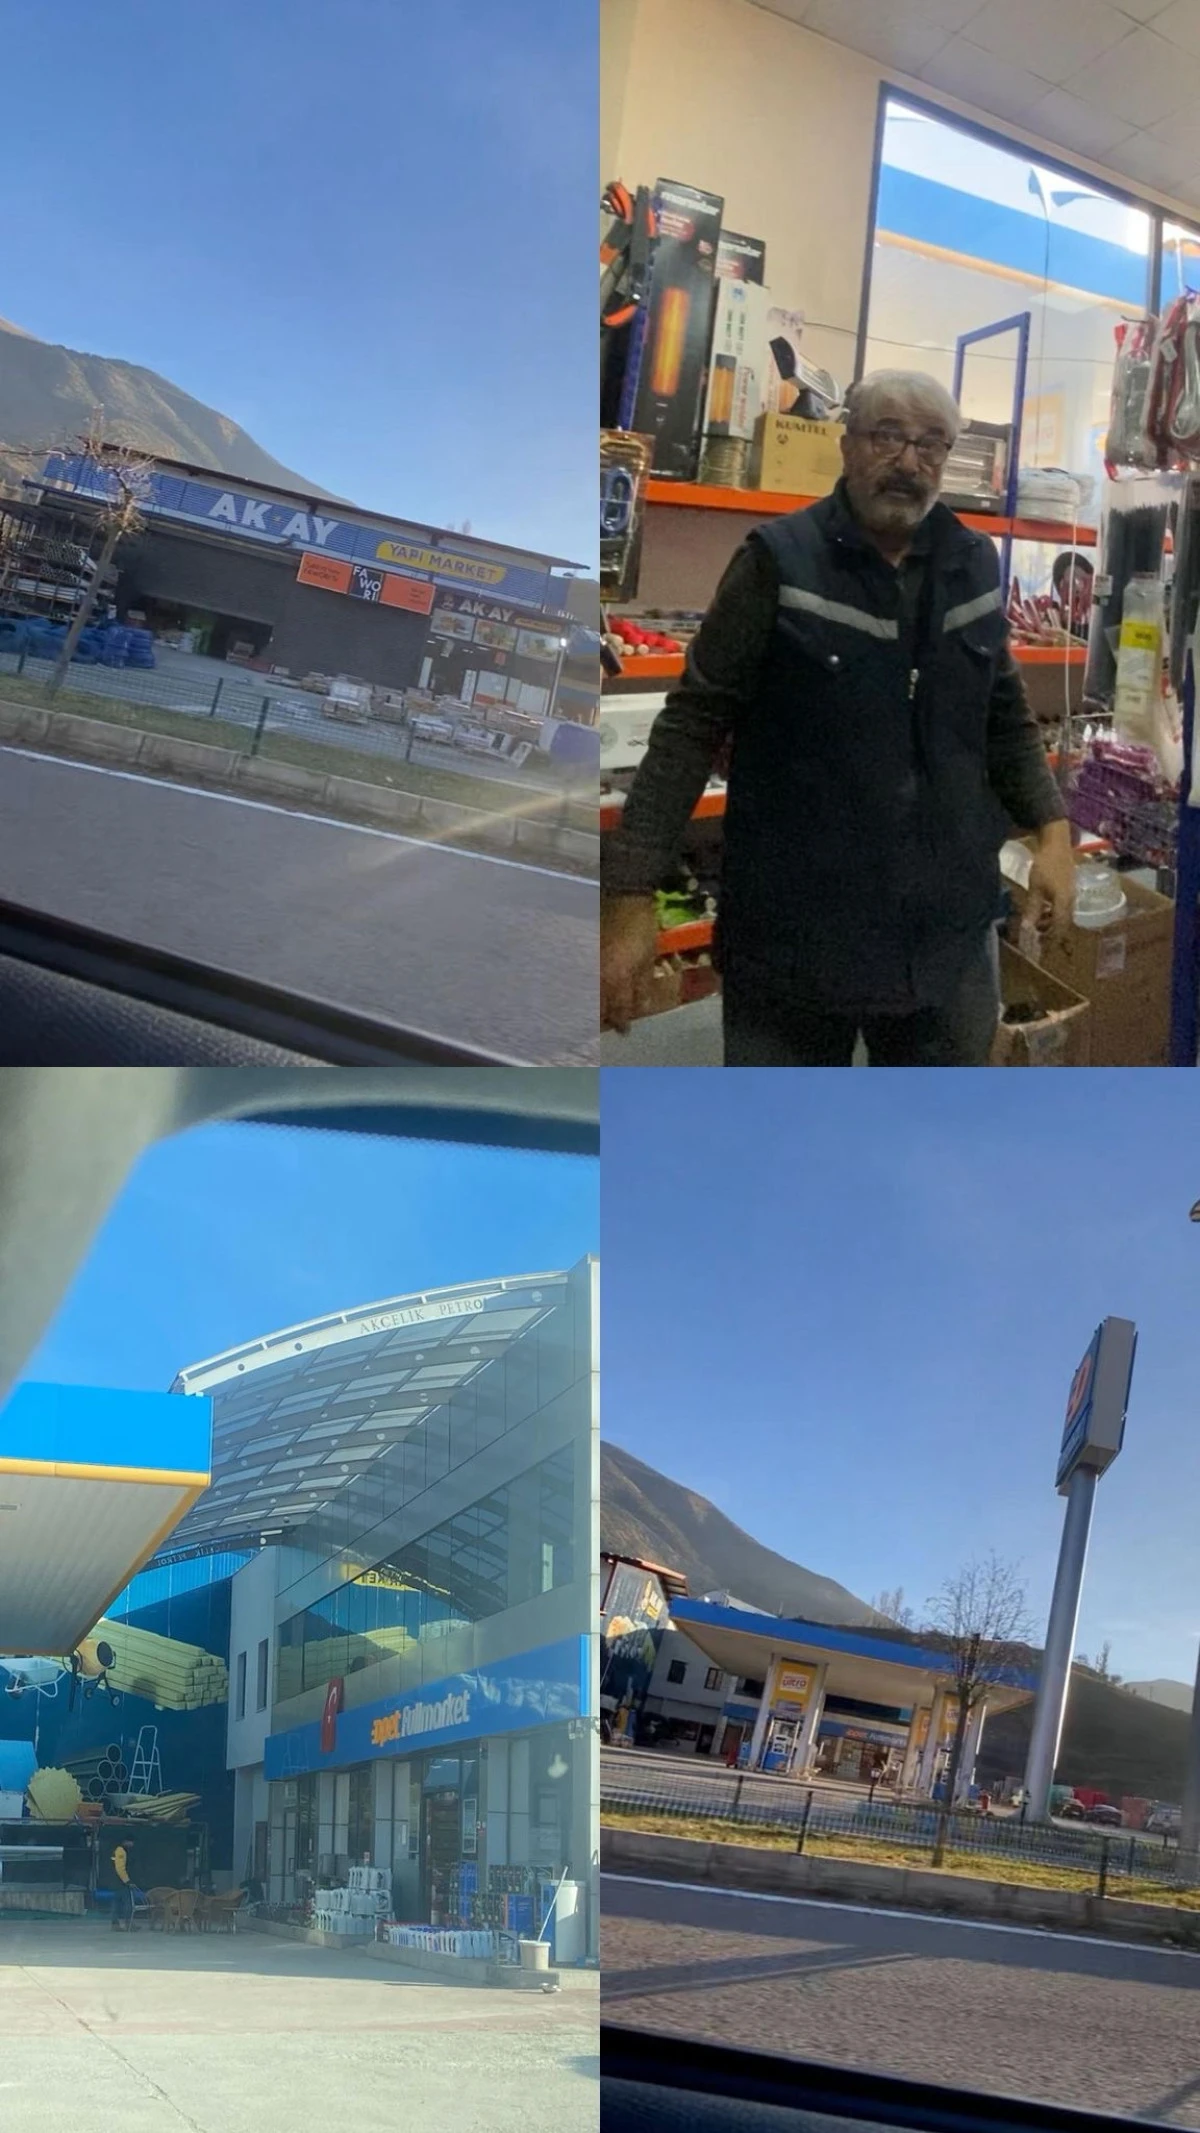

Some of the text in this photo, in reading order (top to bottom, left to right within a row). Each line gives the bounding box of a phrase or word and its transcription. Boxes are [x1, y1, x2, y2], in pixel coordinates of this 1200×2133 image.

[390, 544, 497, 579] YAPI MARKET
[440, 1299, 483, 1315] PETRO
